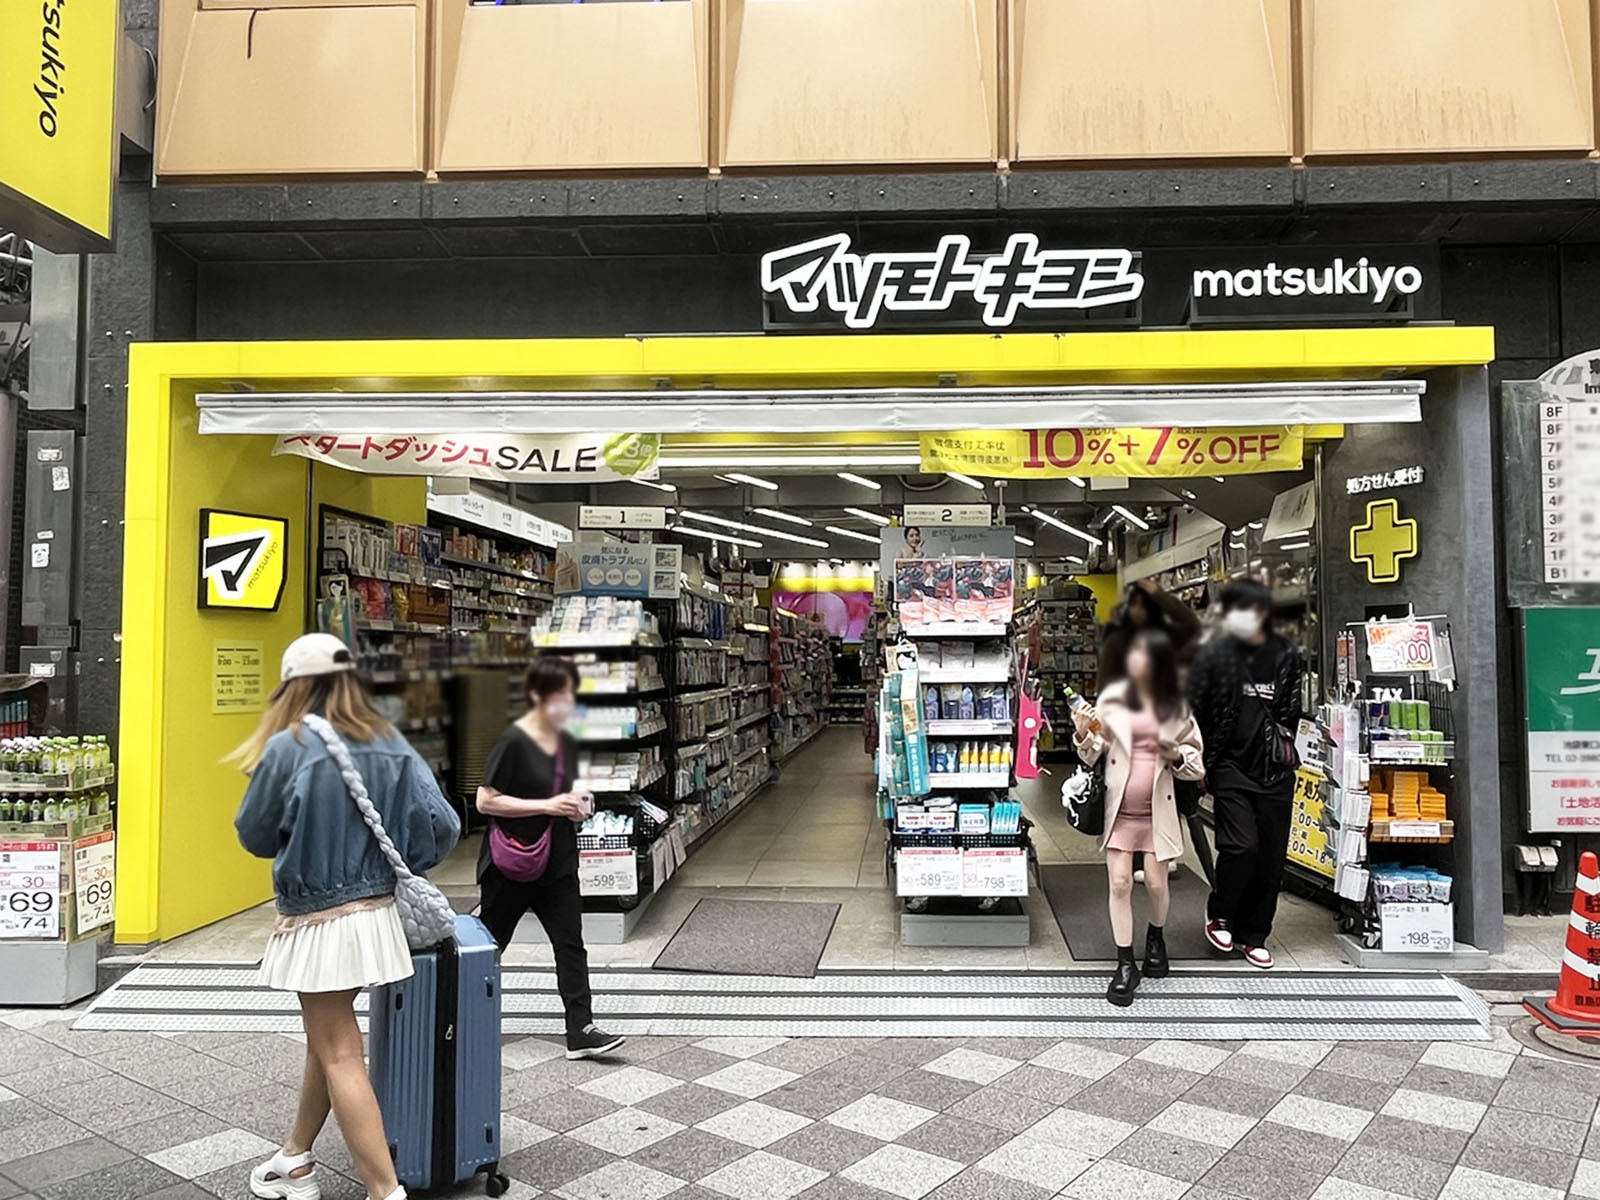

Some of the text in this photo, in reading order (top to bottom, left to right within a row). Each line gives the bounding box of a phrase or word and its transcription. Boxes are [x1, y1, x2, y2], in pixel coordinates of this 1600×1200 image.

[1193, 257, 1423, 304] matsukiyo
[1546, 406, 1563, 417] 8F
[1547, 424, 1563, 435] 8F
[1547, 441, 1562, 452] 7F
[495, 446, 597, 472] SALE
[1346, 466, 1424, 495] 処方せん受付
[620, 510, 626, 524] 1
[941, 508, 952, 522] 2
[248, 541, 278, 589] matsukiyo
[1551, 567, 1567, 579] B1
[1371, 687, 1403, 702] TAX
[22, 876, 44, 888] 30
[593, 874, 615, 887] 598
[920, 873, 941, 886] 589
[983, 876, 1006, 889] 798
[86, 880, 112, 904] 69
[9, 891, 53, 912] 69
[94, 904, 110, 919] 74
[20, 916, 48, 929] 74
[1407, 932, 1430, 945] 198
